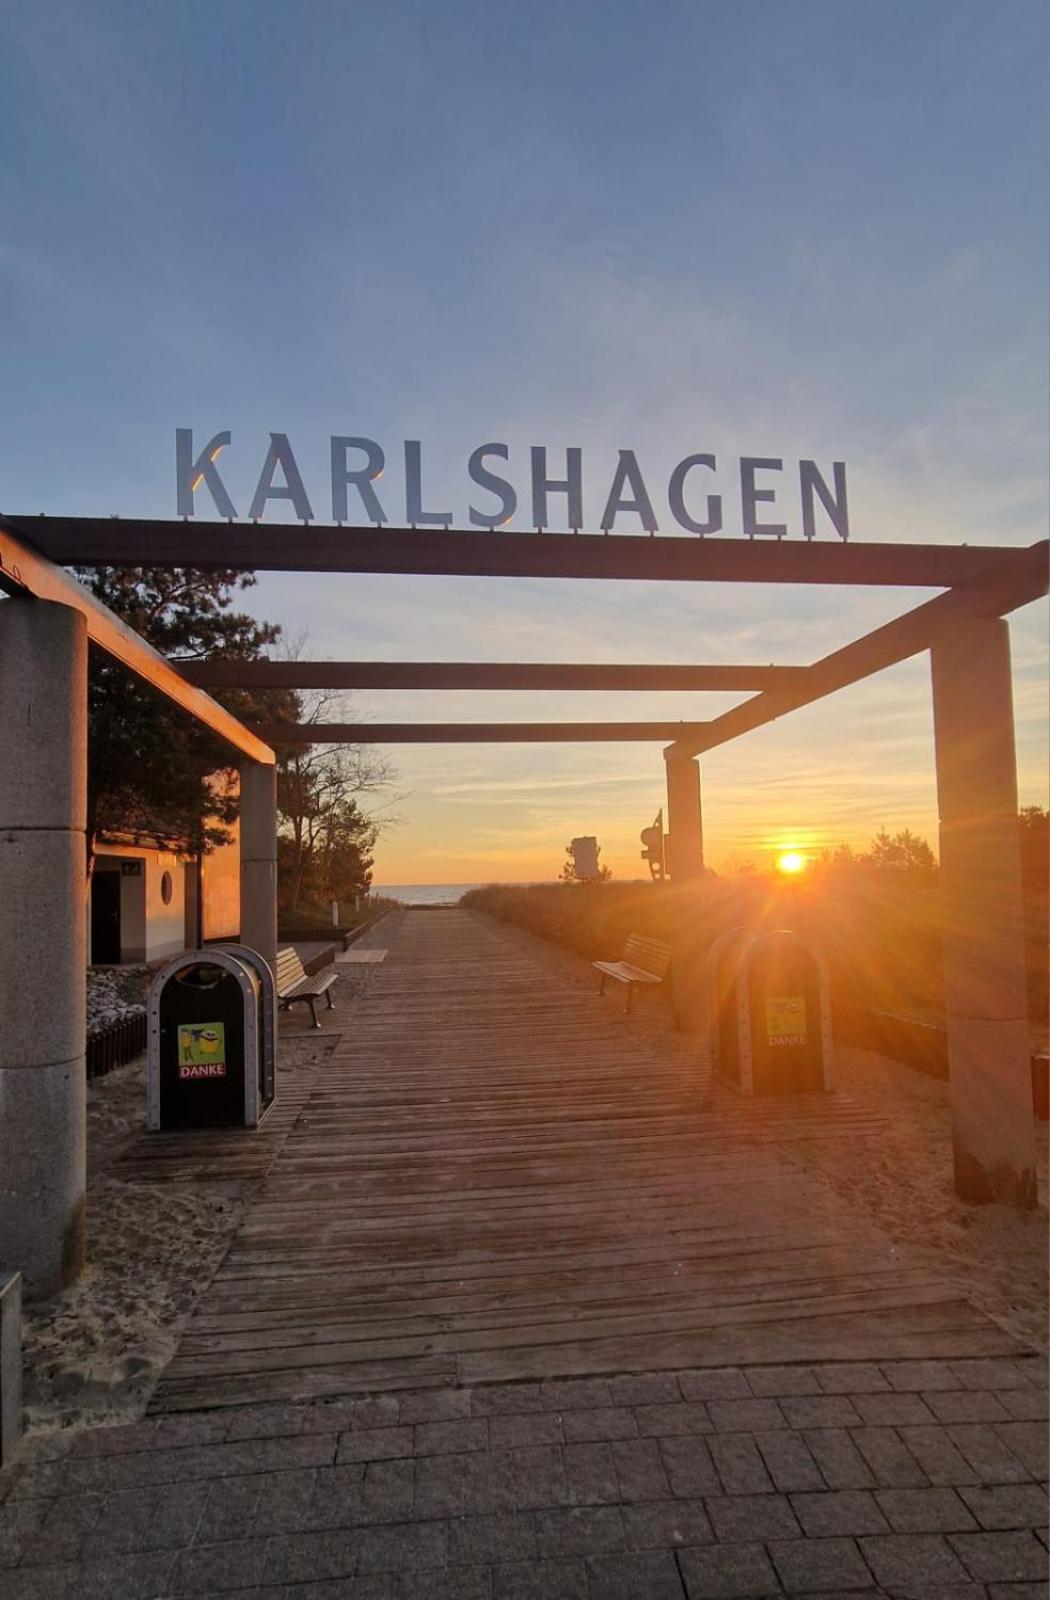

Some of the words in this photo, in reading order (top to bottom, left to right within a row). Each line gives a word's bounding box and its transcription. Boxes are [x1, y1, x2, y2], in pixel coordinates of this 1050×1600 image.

[176, 428, 848, 538] KARLSHAGEN
[768, 1033, 806, 1046] DANKE
[180, 1064, 224, 1077] DANKE
